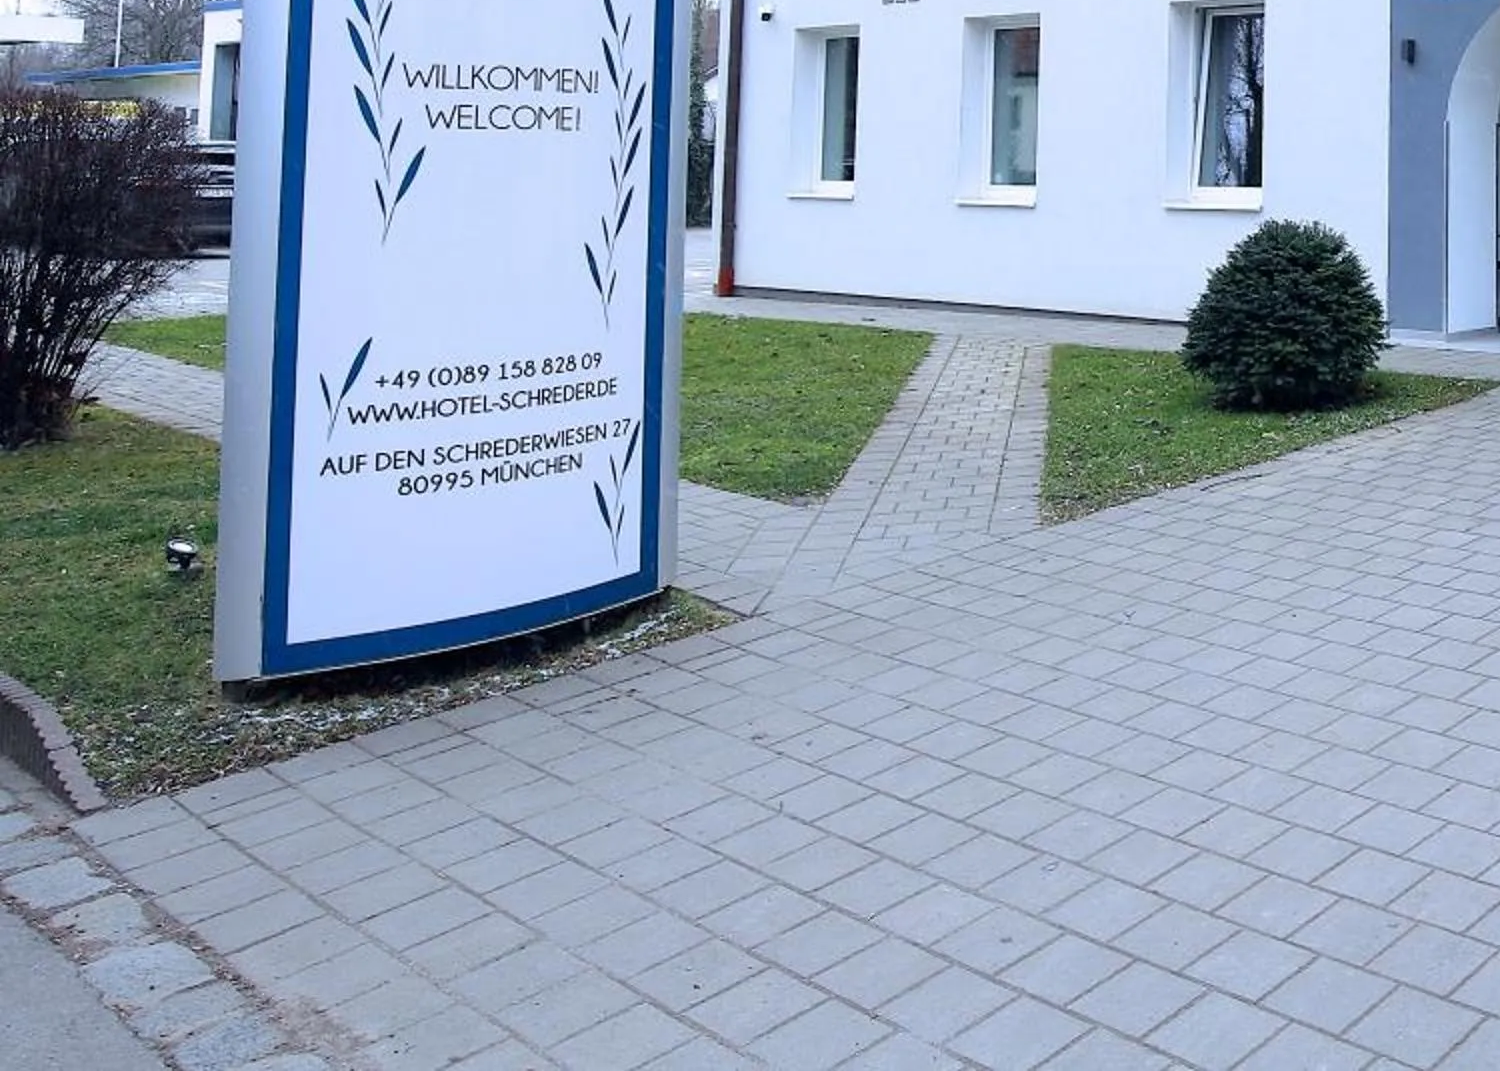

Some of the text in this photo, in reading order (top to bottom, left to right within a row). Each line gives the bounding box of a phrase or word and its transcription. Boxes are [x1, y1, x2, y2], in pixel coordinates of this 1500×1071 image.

[402, 62, 600, 94] WILLKOMMEN!
[425, 104, 582, 132] WELCOME!
[374, 352, 602, 389] +49 (0)89 158 828 09
[320, 418, 631, 477] AUF DEN SCHREDERWIESEN 27
[397, 452, 583, 496] 80995 MÜNCHEN
